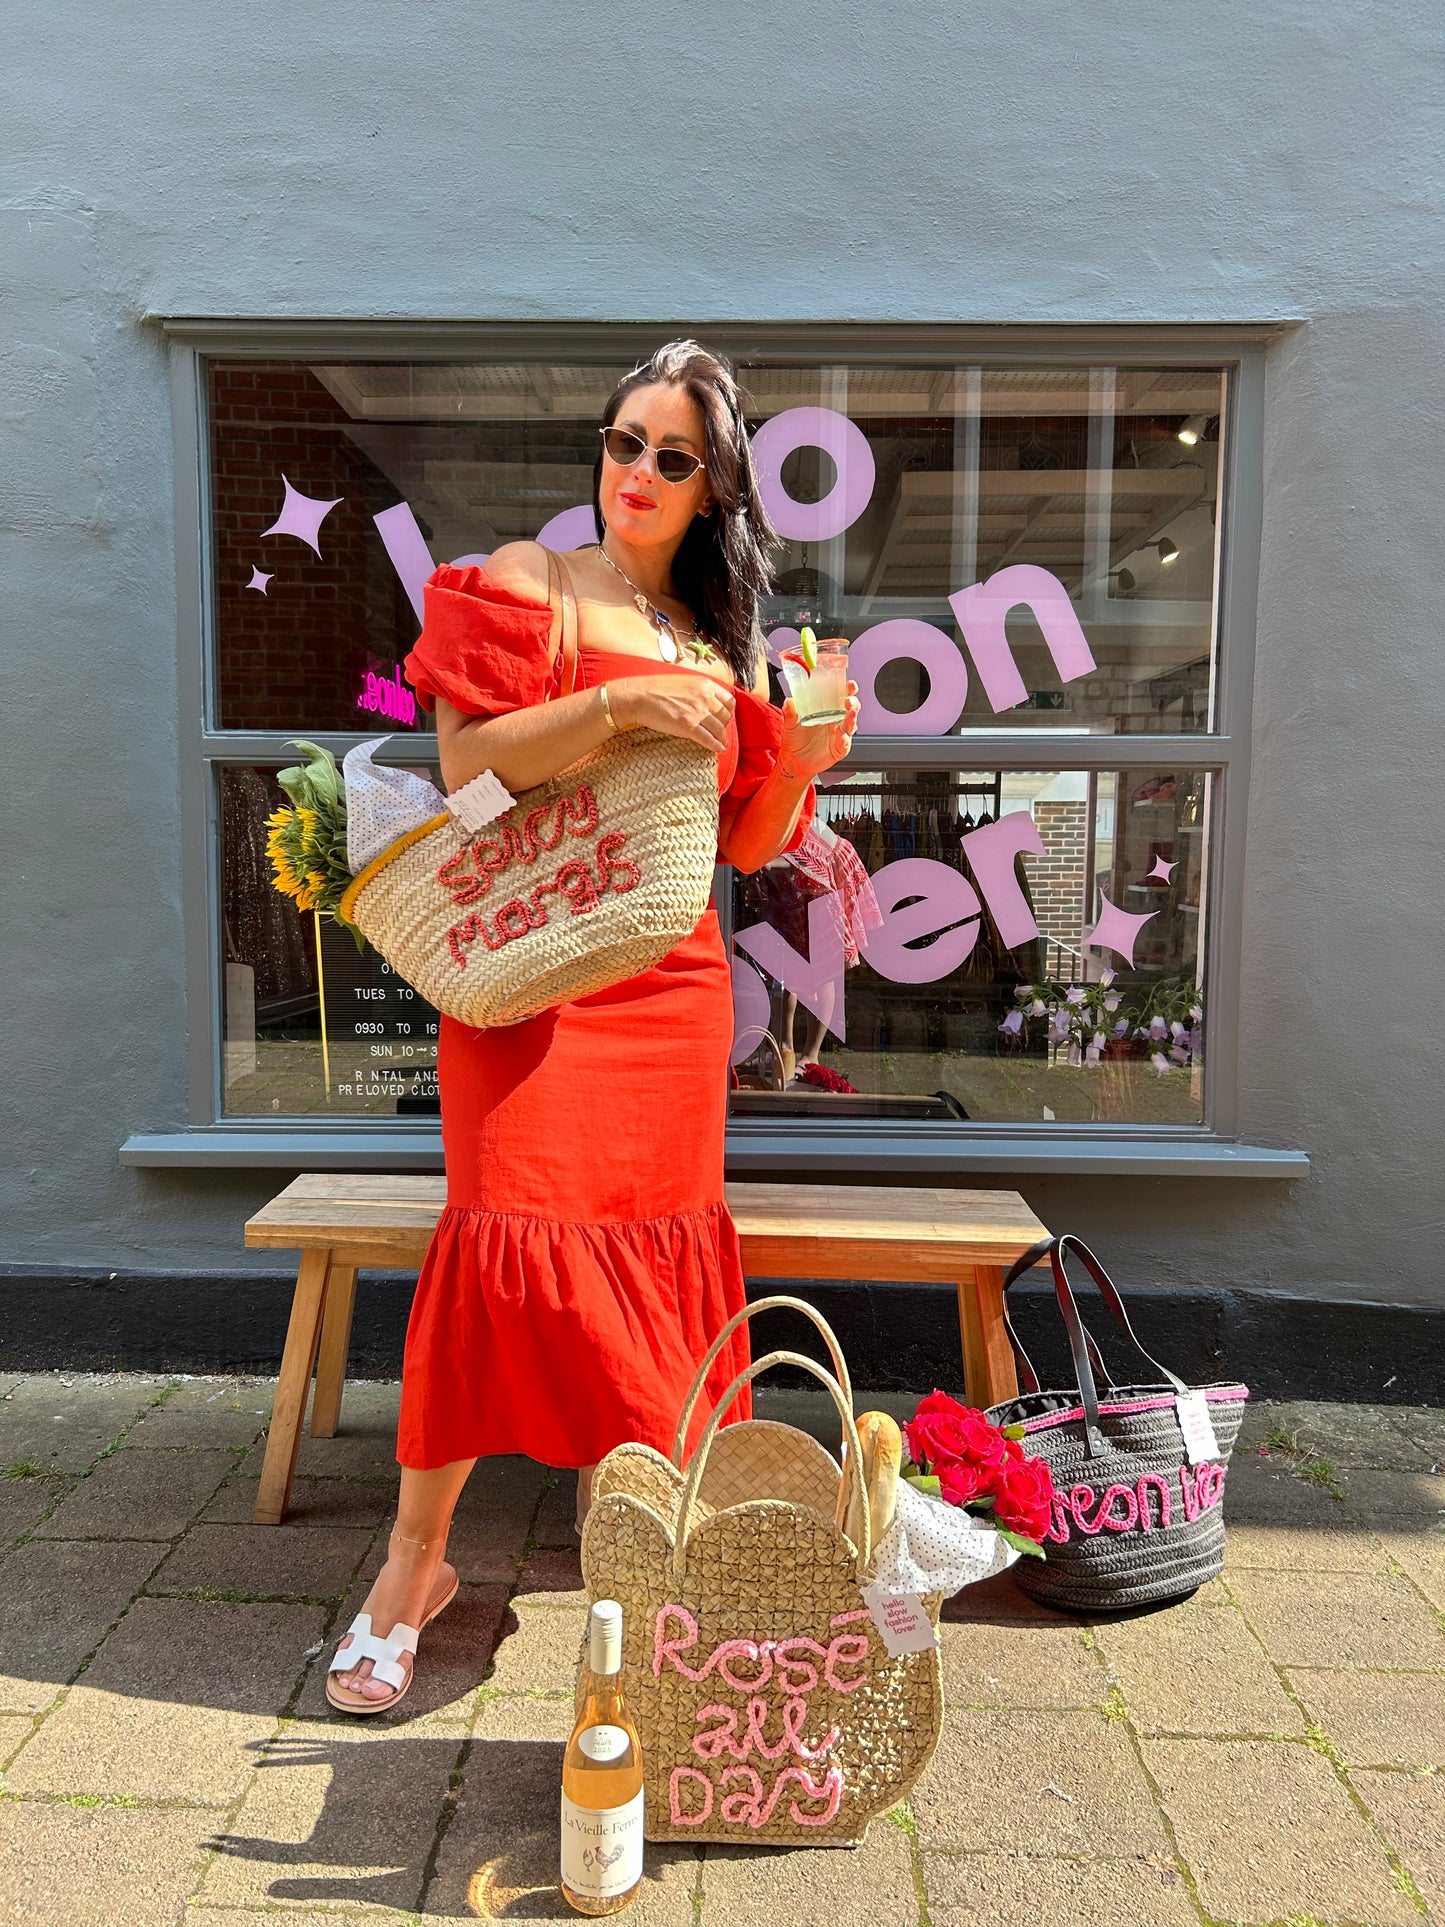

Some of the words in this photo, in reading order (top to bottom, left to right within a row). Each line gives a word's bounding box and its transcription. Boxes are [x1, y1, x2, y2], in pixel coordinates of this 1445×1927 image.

[437, 785, 599, 905] Spicy
[447, 831, 640, 971] Margs
[354, 988, 386, 1000] TUES
[397, 988, 414, 1000] TO
[355, 1023, 384, 1034] 0930
[396, 1023, 411, 1034] TO
[425, 1023, 441, 1034] 16
[370, 1045, 393, 1057] SUN
[414, 1070, 439, 1082] AND
[881, 1599, 905, 1610] hello
[887, 1608, 908, 1618] slow
[884, 1614, 919, 1628] fashion
[893, 1624, 917, 1635] lover
[693, 1696, 840, 1759] all
[669, 1764, 845, 1828] Day
[575, 1819, 609, 1836] Vieille
